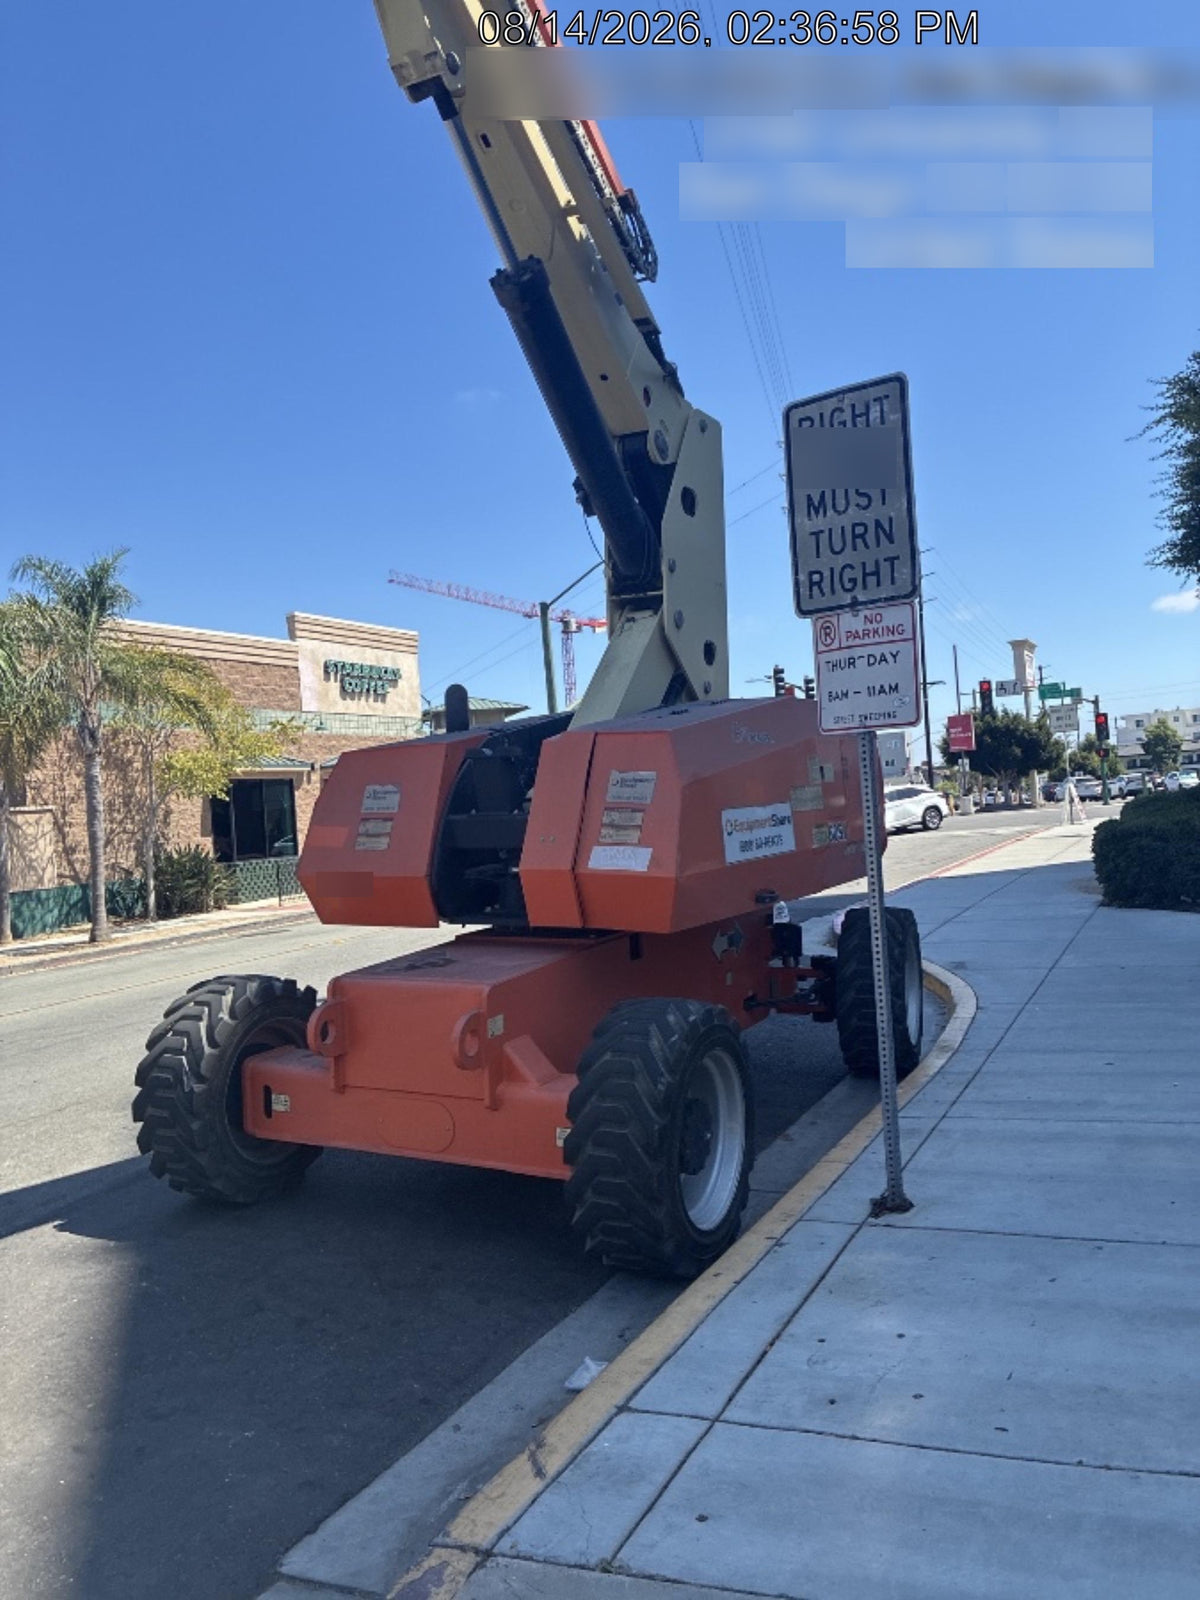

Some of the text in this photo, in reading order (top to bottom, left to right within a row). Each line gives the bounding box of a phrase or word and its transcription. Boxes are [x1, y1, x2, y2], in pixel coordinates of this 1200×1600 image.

[809, 516, 895, 558] TURN
[808, 555, 899, 599] RIGHT
[863, 613, 882, 625] NO
[845, 623, 906, 641] PARKING
[825, 650, 900, 672] THURDAY
[867, 682, 899, 697] 11AM
